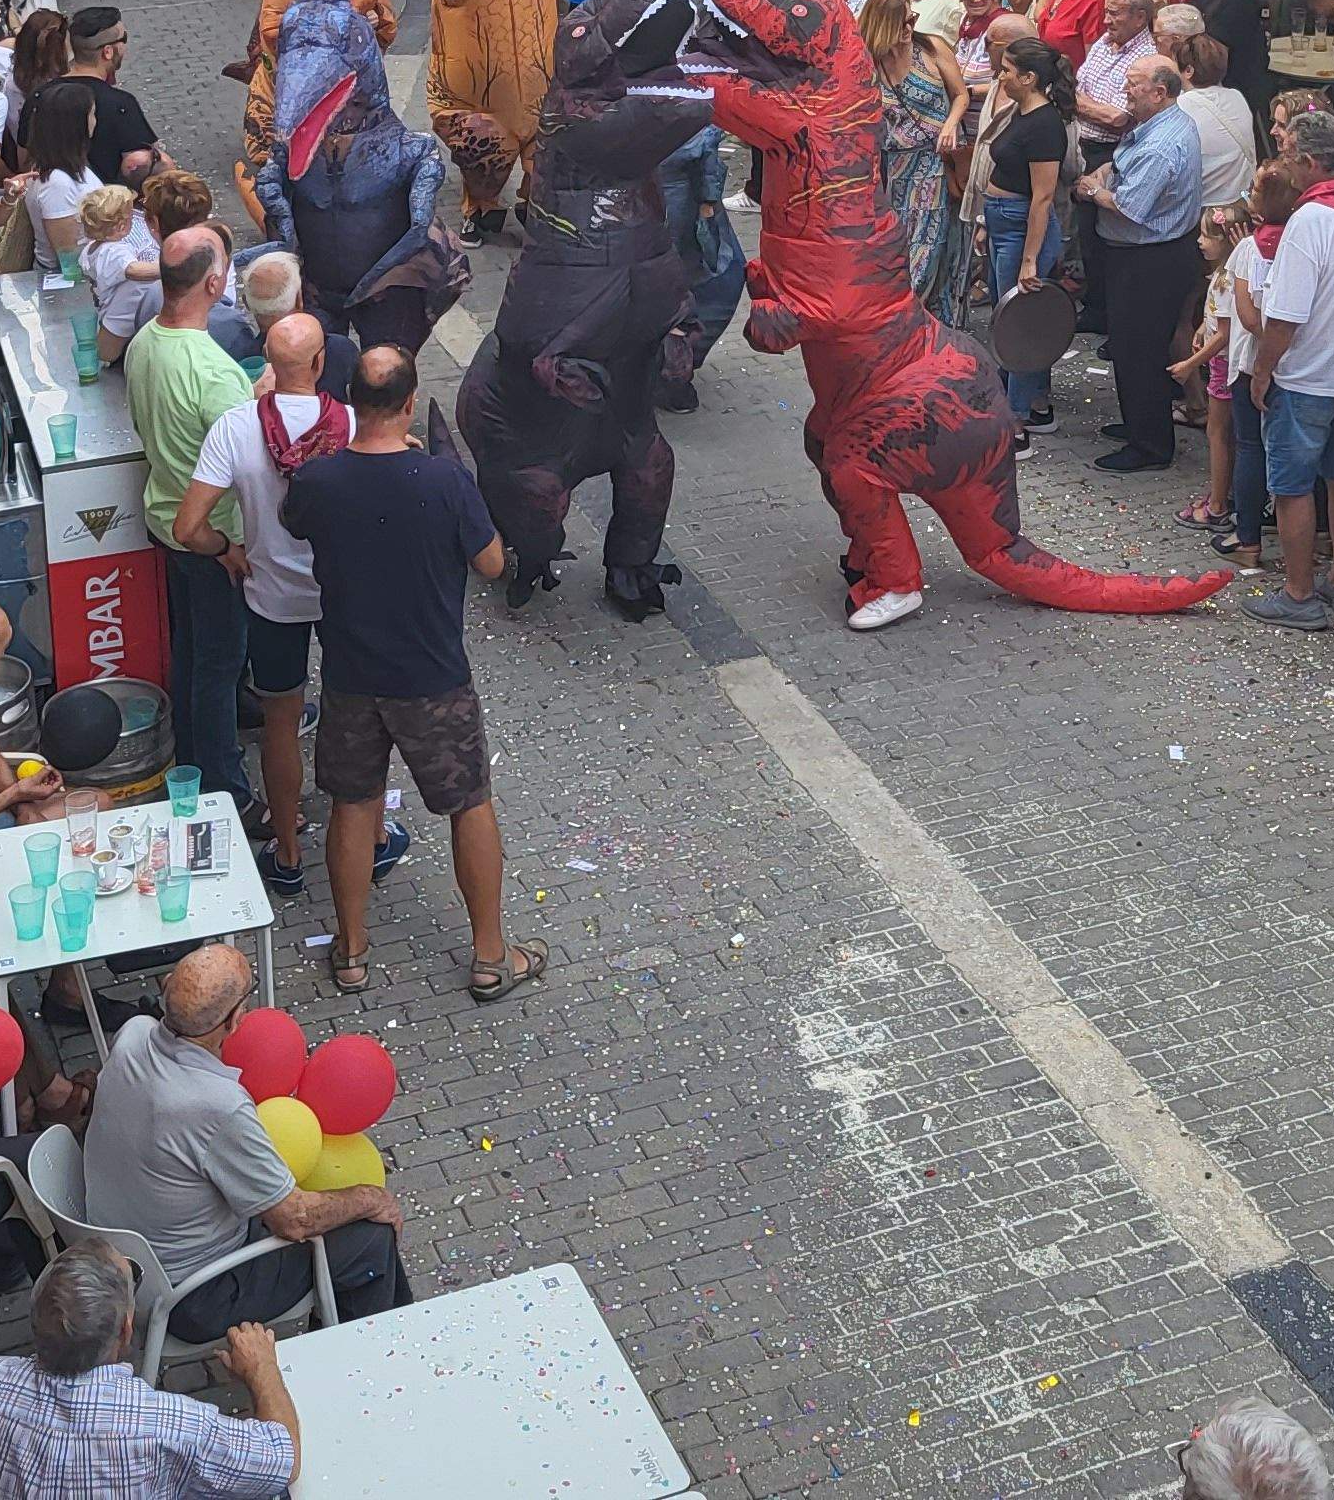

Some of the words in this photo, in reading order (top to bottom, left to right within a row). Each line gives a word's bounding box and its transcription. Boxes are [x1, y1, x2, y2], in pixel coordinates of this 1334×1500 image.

[84, 509, 111, 519] 1900
[86, 567, 125, 679] MBAR
[637, 1448, 664, 1484] AMBAR
